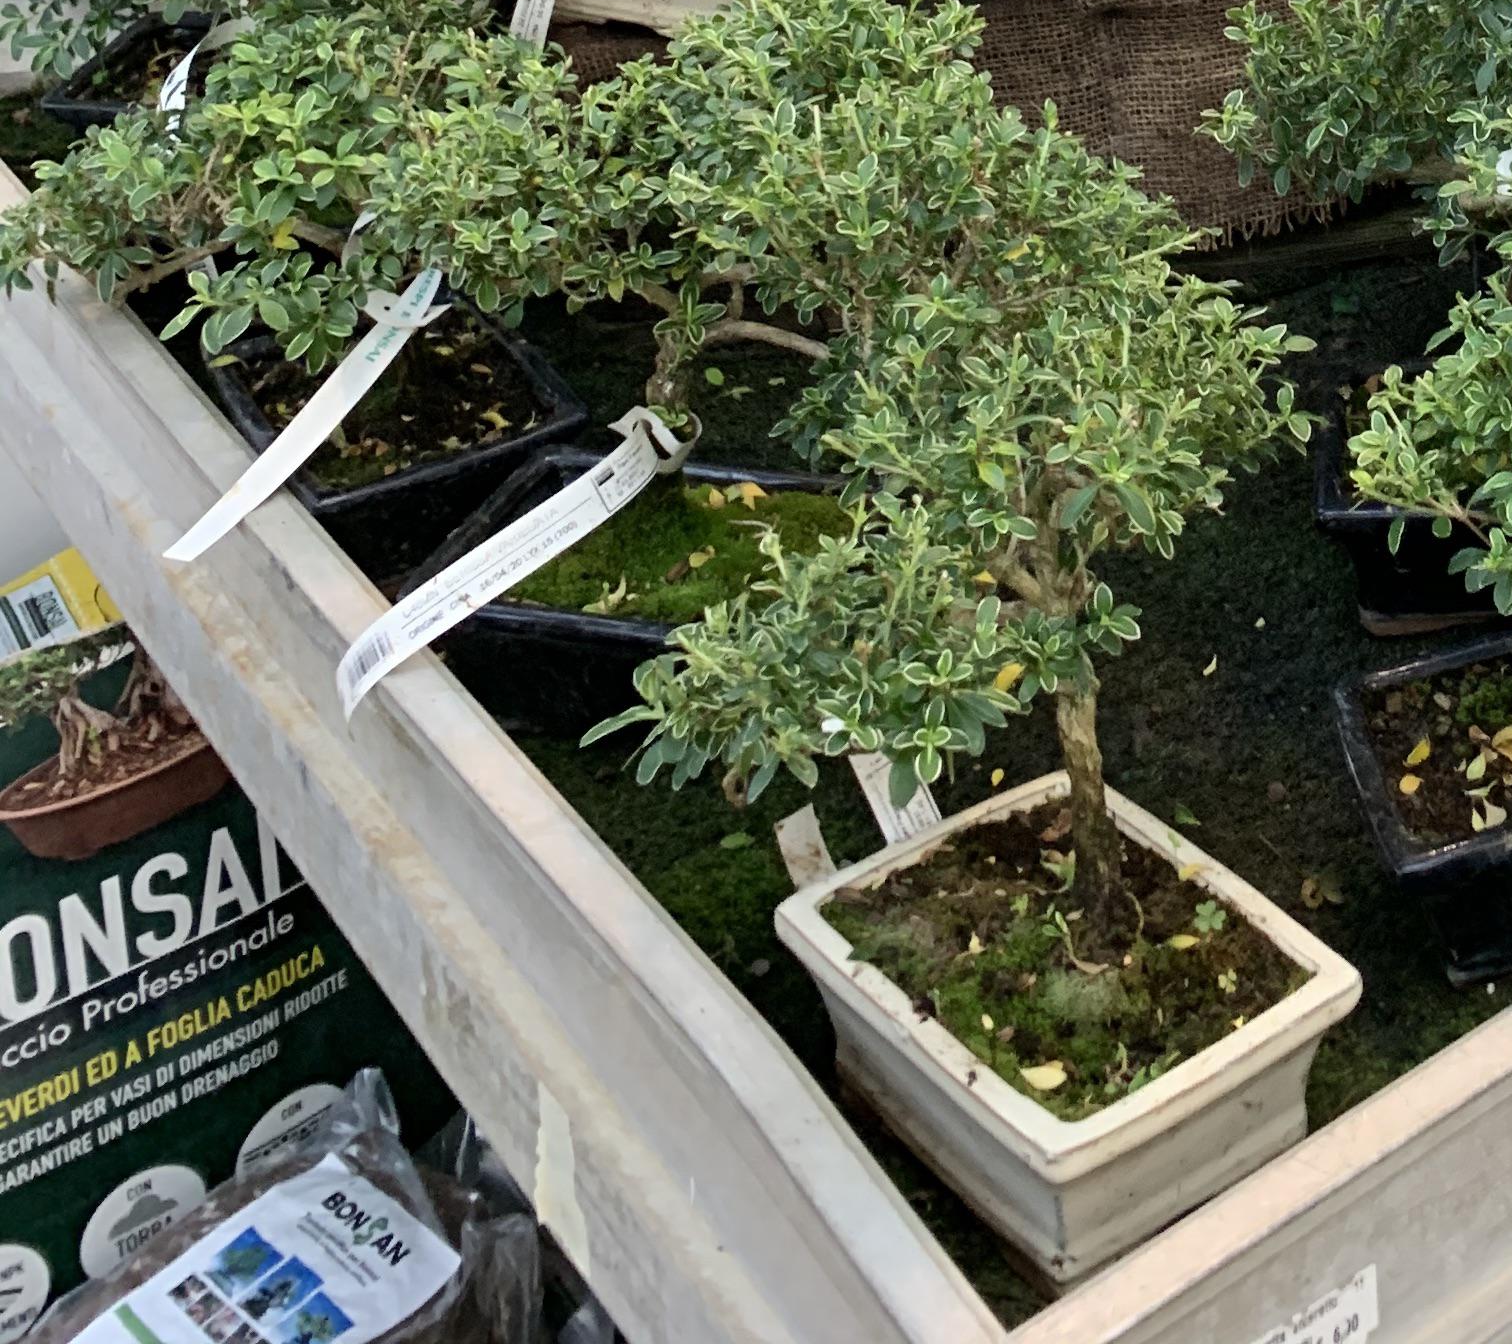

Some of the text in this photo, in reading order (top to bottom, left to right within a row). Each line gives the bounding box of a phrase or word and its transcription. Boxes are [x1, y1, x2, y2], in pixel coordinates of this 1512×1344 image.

[0, 808, 283, 1023] ONSAI
[1, 910, 295, 1068] ccio Professionale
[0, 944, 326, 1130] EVERDI ED A FOGLIA CADUCA
[0, 967, 350, 1162] ECIFICA PER VASI DI DIMENSIONI RIDOTTE
[97, 1121, 124, 1146] UN
[127, 1093, 177, 1132] BUON
[182, 1038, 280, 1104] DRENAGGIO
[126, 1179, 152, 1202] CON
